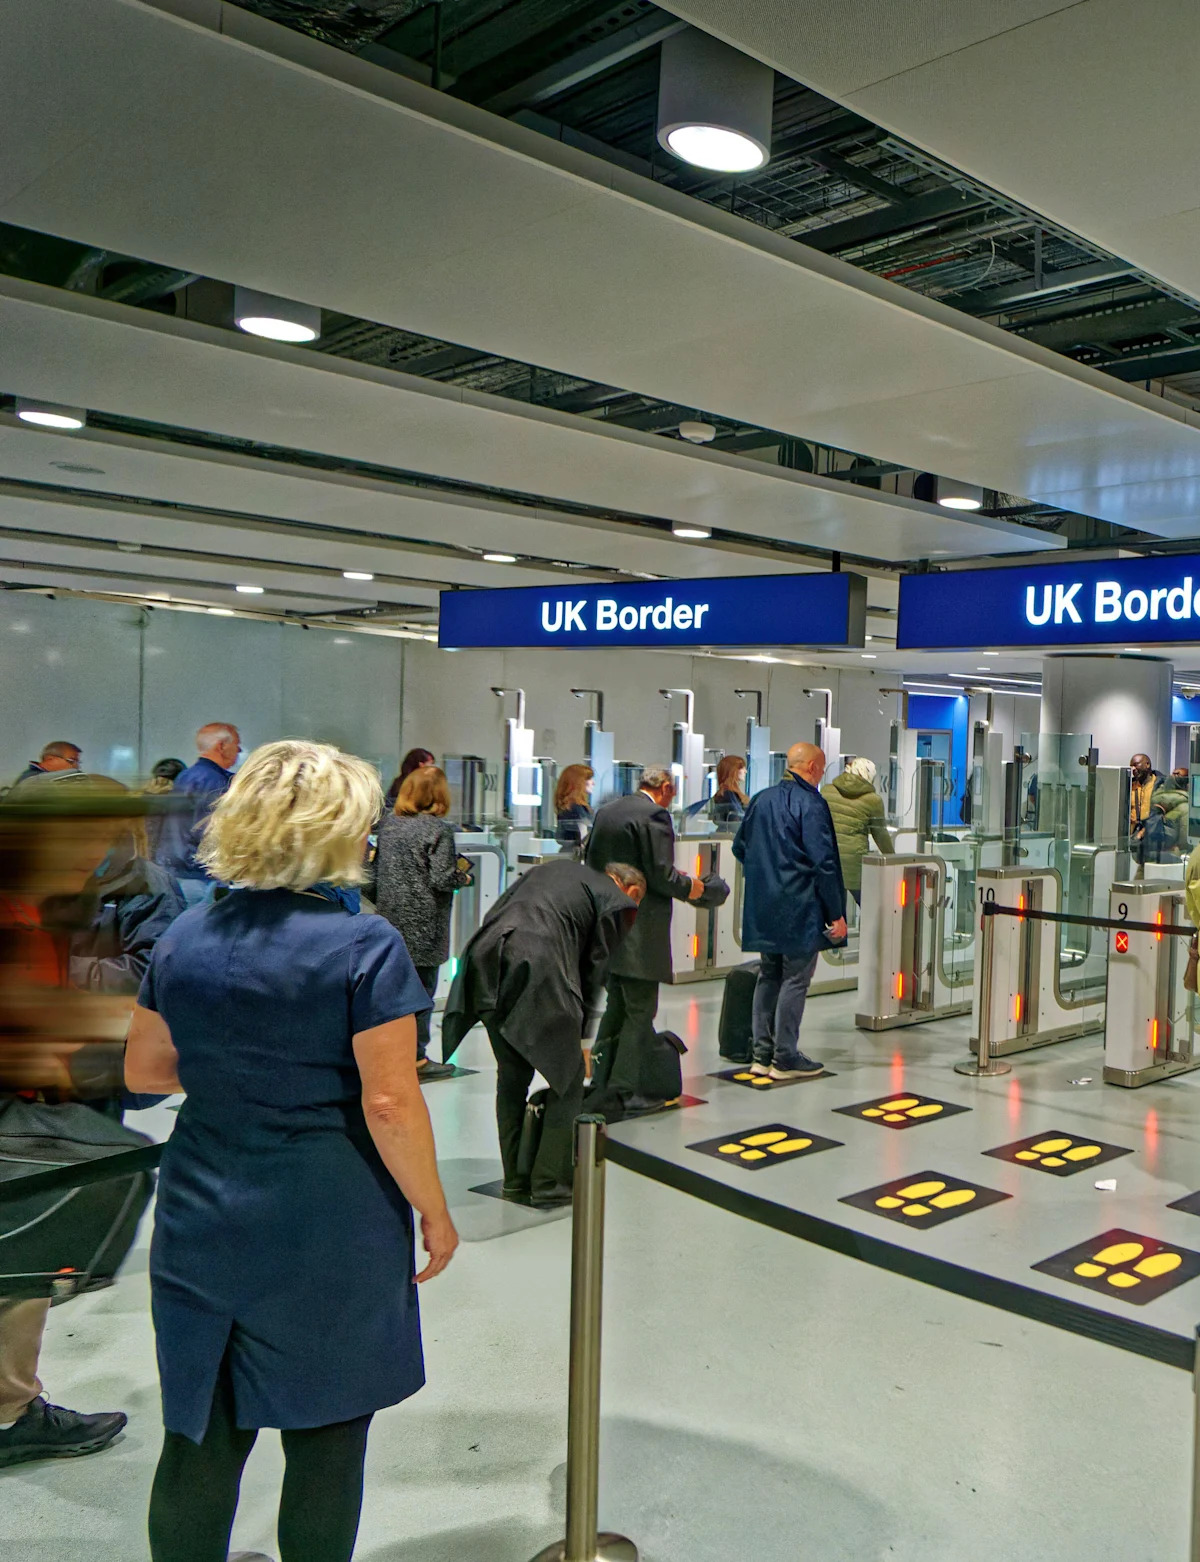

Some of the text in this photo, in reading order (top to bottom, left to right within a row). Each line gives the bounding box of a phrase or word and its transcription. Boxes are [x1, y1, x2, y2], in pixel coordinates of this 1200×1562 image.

[541, 597, 709, 632] UK Border
[1025, 583, 1083, 626] UK
[978, 886, 995, 904] 10
[1118, 902, 1129, 922] 9
